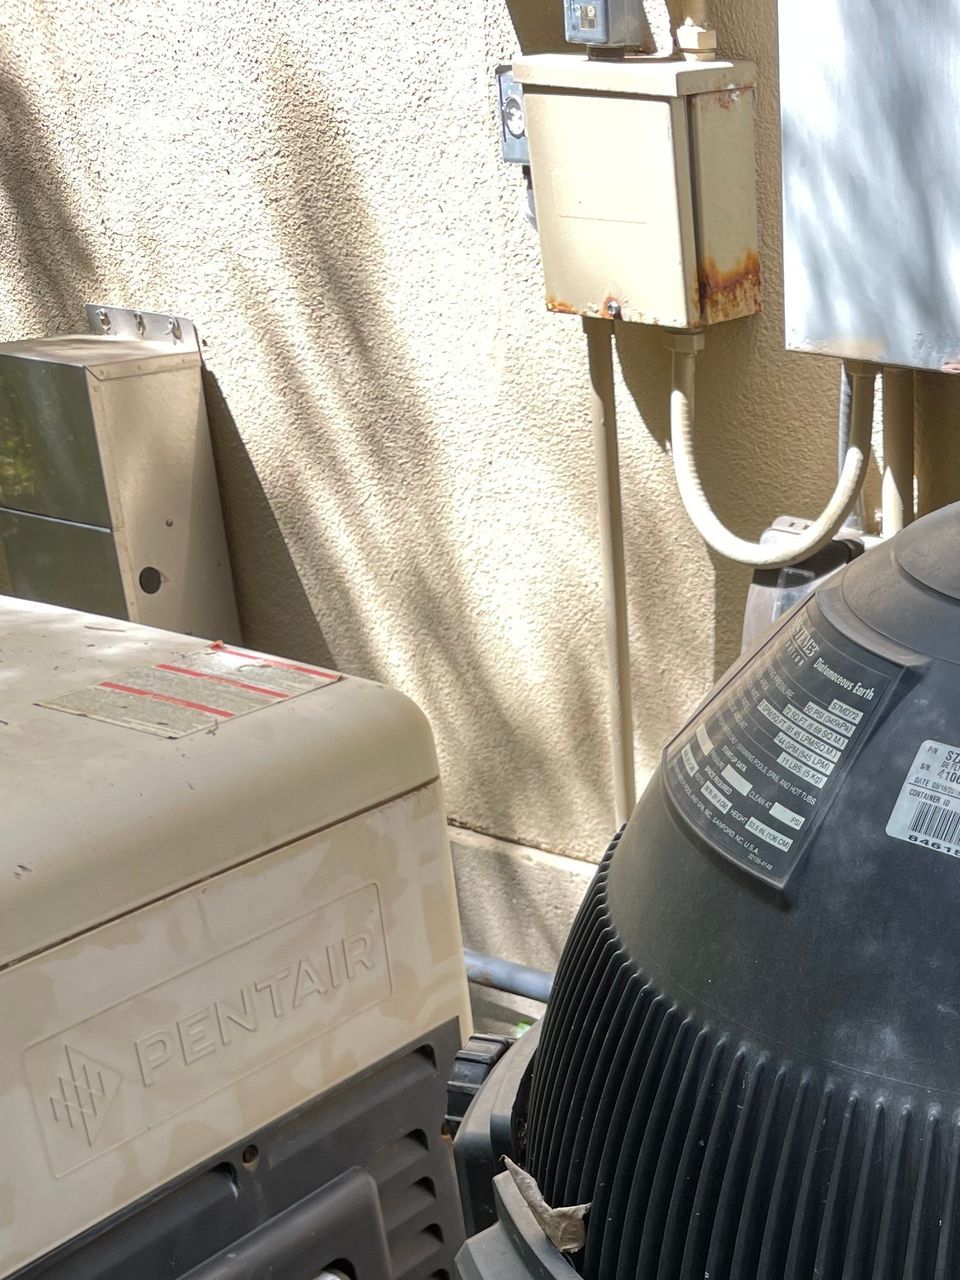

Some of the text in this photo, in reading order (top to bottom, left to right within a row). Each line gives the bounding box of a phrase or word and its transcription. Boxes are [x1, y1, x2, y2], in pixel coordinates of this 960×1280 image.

[811, 655, 877, 701] Diatomaceous Earth
[803, 704, 814, 714] 50
[811, 708, 825, 720] PSI
[830, 701, 859, 721] S7MD72
[783, 740, 800, 754] GPM
[810, 755, 832, 771] LPM)
[926, 745, 938, 755] P/N
[780, 755, 790, 765] 11
[808, 772, 823, 785] Kg)
[940, 760, 950, 769] DE
[913, 775, 929, 787] DATE
[747, 790, 766, 806] CLEAN
[788, 785, 802, 796] HOT
[908, 787, 941, 804] CONTAINER
[942, 798, 951, 807] ID
[728, 808, 748, 824] HEIGHT
[134, 926, 378, 1089] PENTAIR
